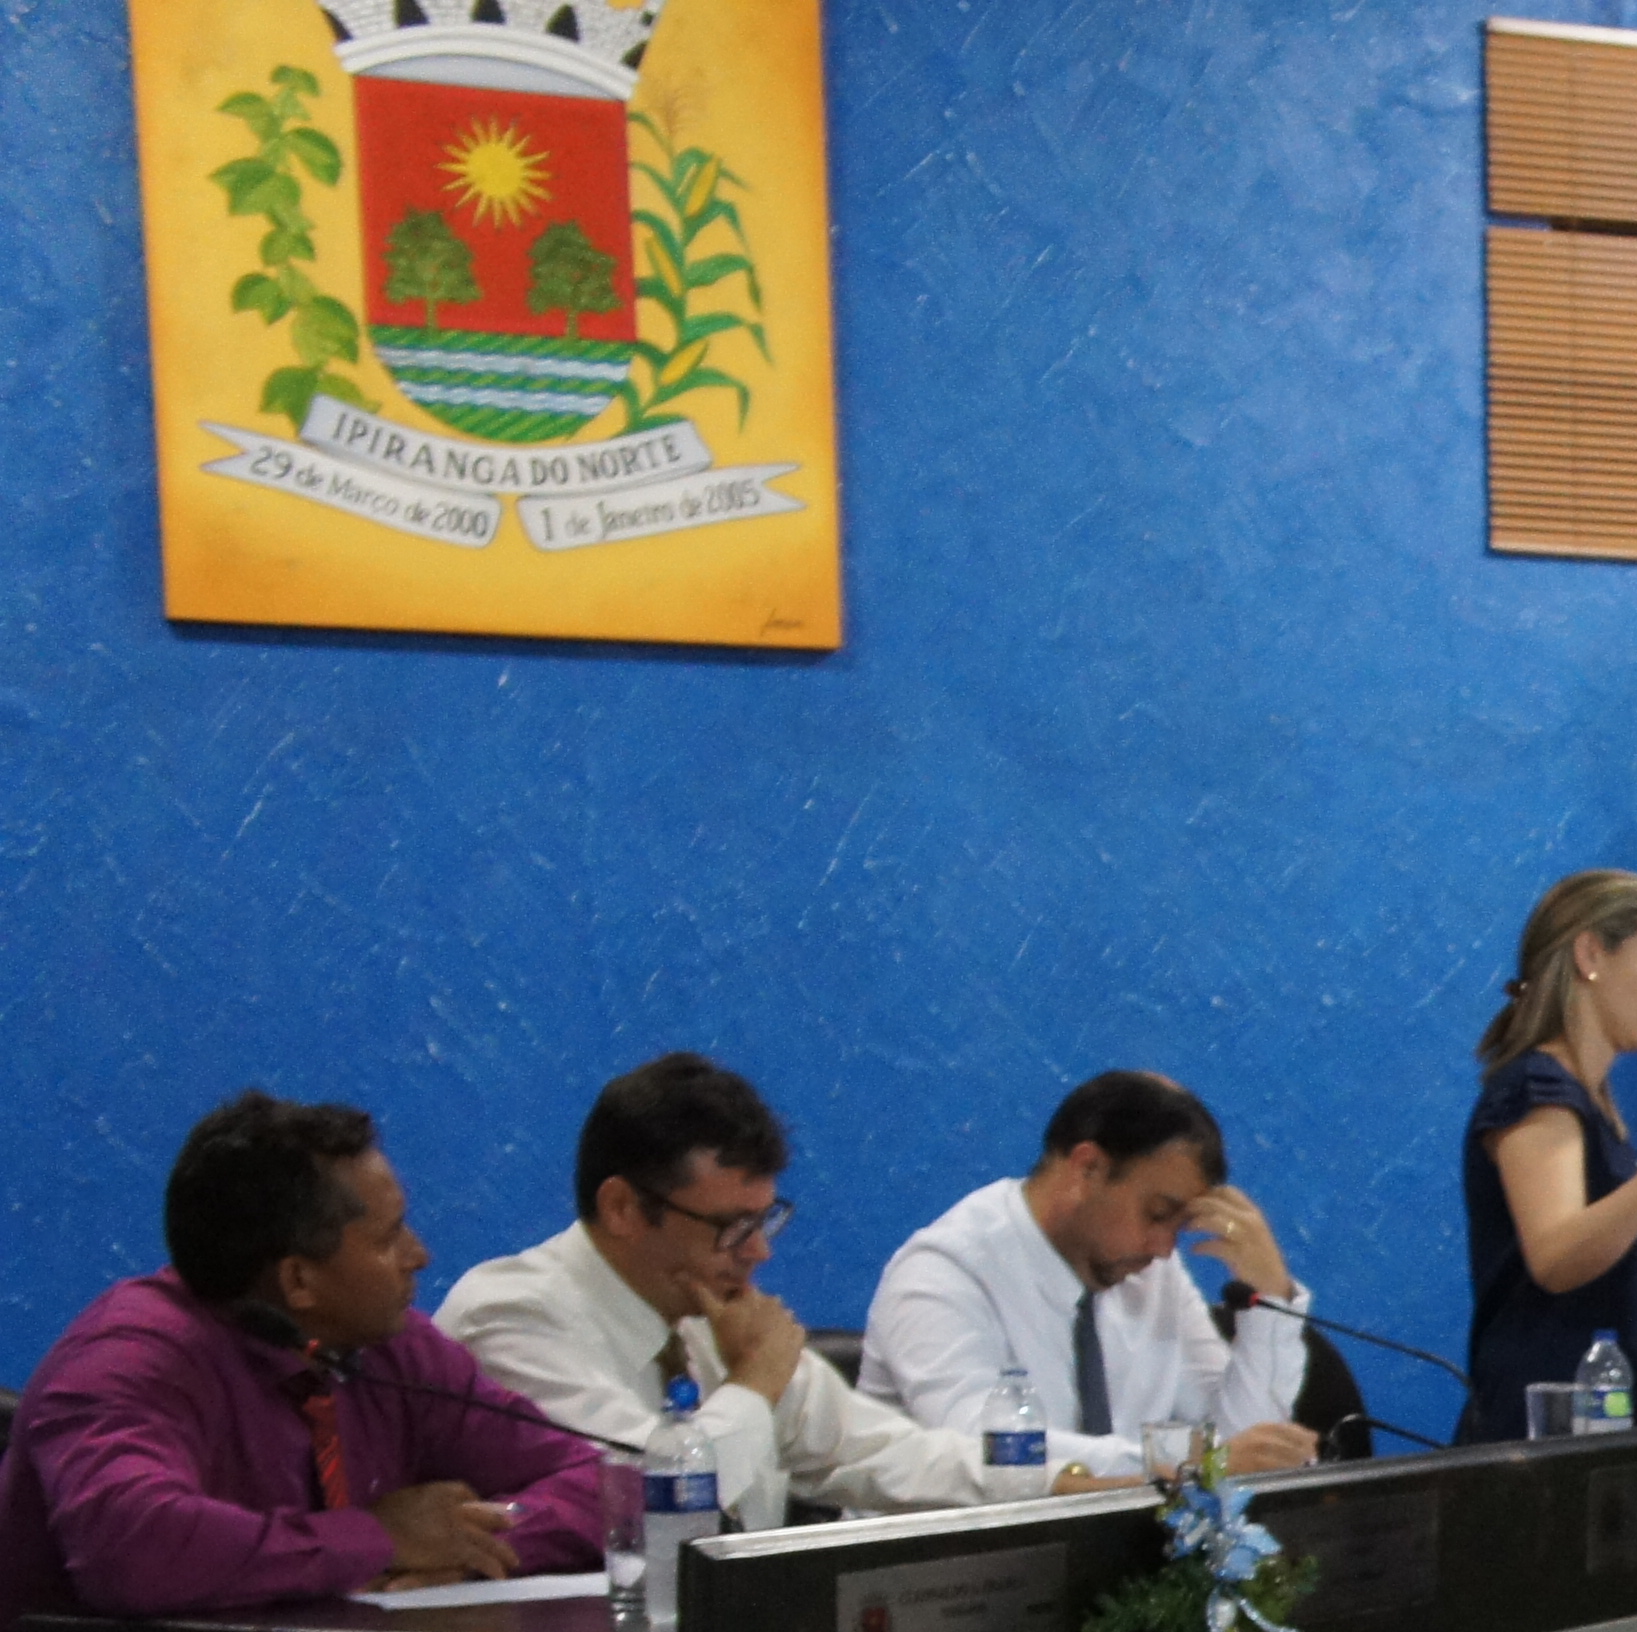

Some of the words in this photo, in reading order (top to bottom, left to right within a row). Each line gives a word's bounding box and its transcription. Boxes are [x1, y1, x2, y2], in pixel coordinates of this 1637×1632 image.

[332, 412, 521, 487] IPIRANGA
[530, 456, 570, 486] DO
[577, 433, 681, 484] NORTE
[250, 445, 293, 478] 29
[296, 464, 323, 487] de
[404, 499, 431, 523] de
[431, 500, 489, 538] 2000
[564, 510, 591, 536] de
[703, 478, 761, 515] 2005
